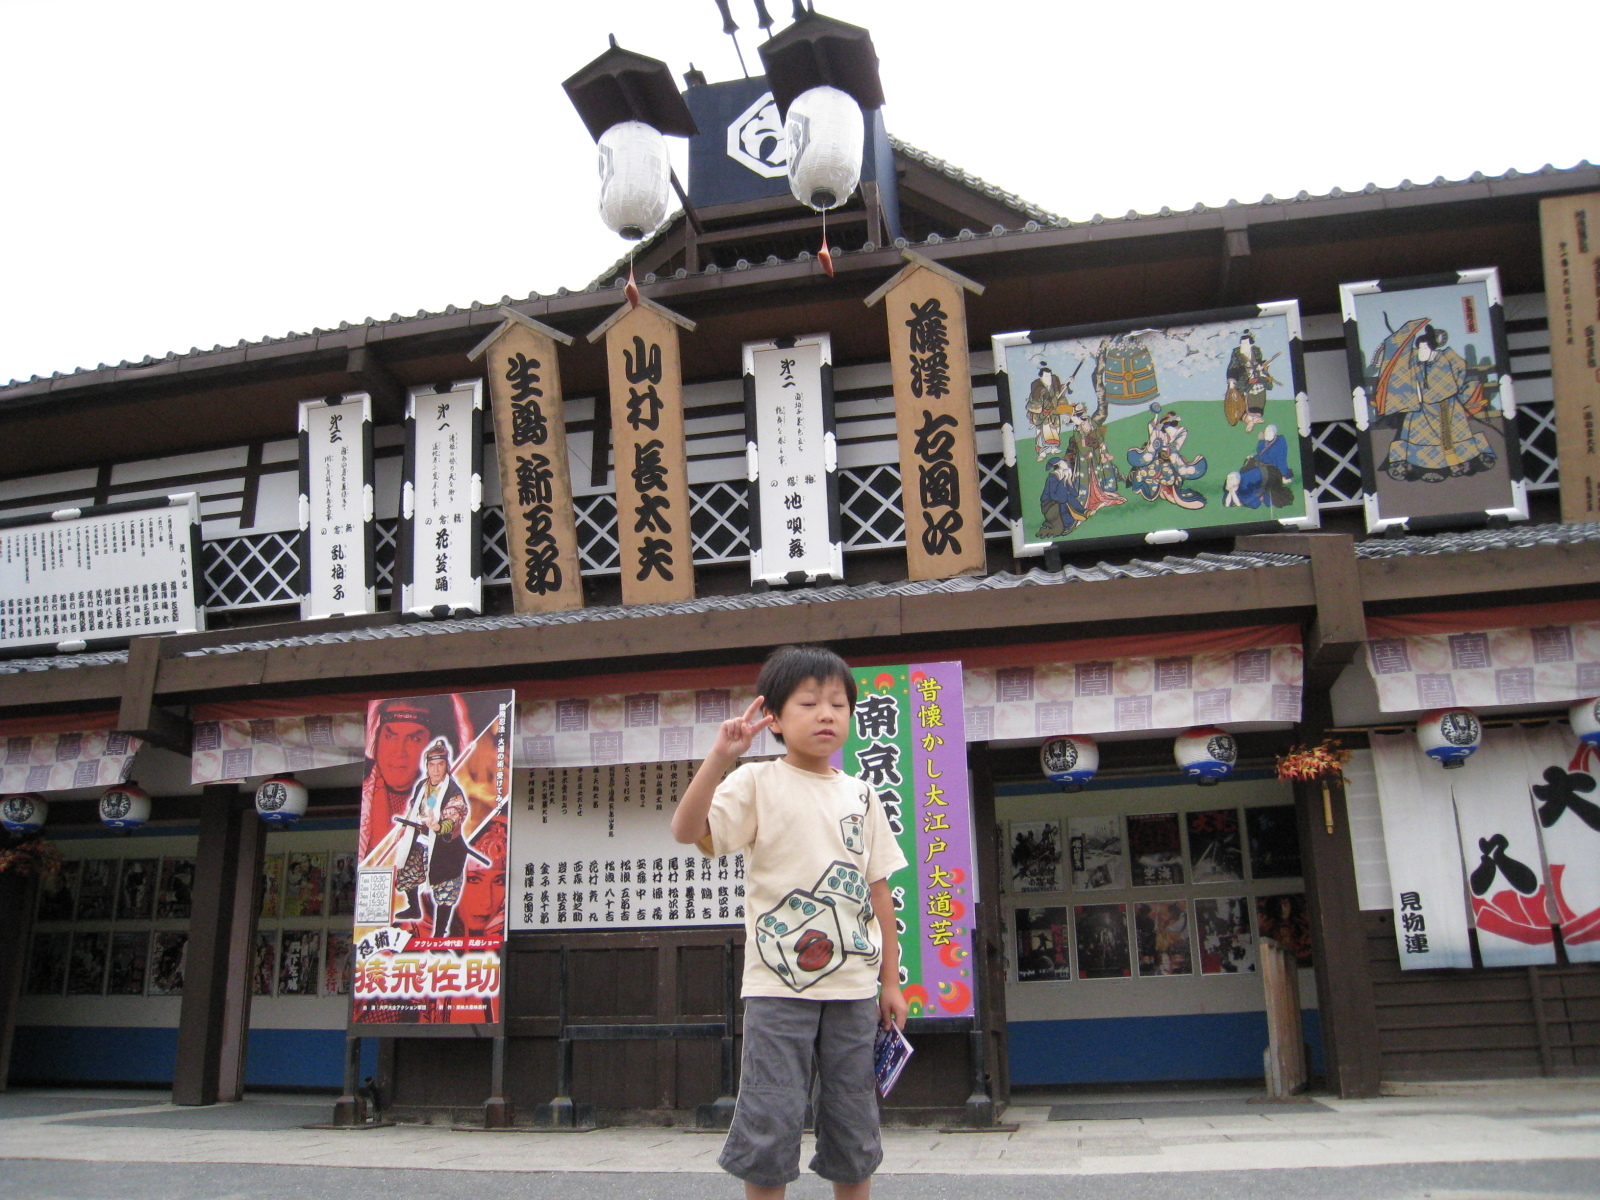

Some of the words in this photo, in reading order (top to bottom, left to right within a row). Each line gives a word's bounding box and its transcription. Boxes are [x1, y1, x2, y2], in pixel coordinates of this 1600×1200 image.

[917, 677, 954, 946] 昔懐かし大江戸大道芸
[354, 957, 500, 993] 猿飛佐助
